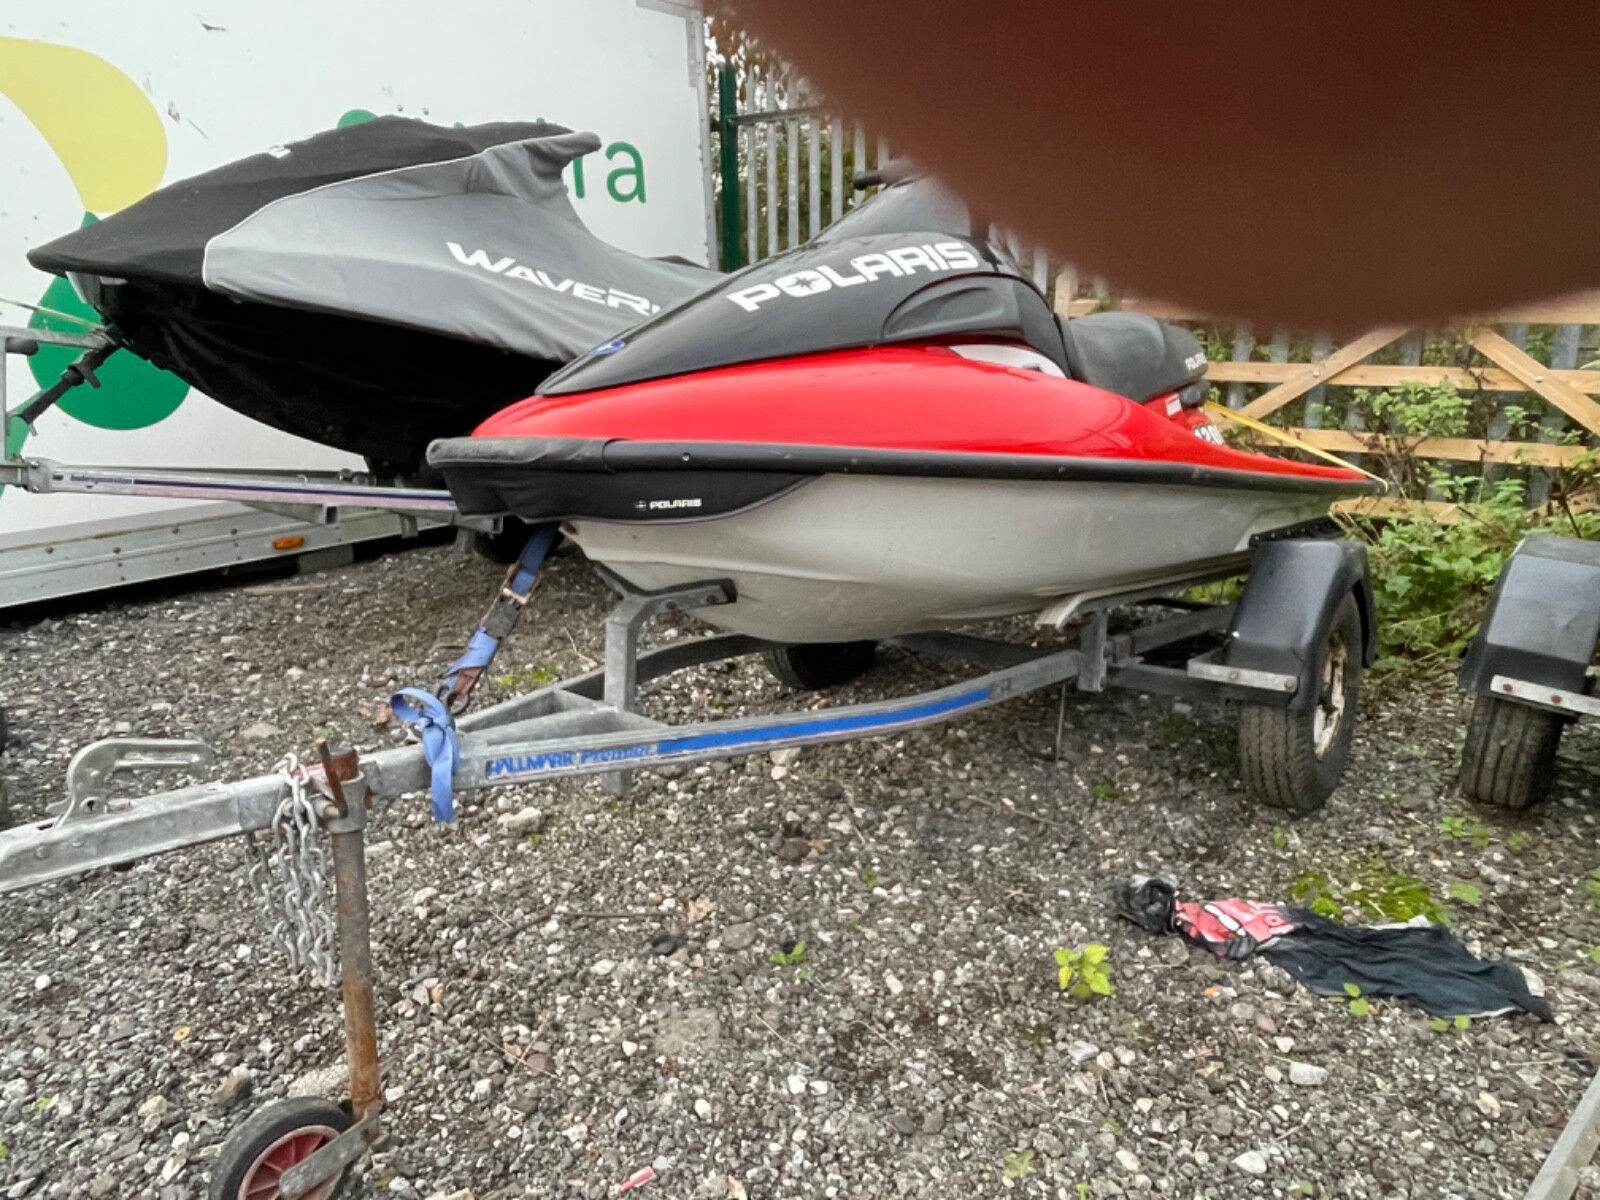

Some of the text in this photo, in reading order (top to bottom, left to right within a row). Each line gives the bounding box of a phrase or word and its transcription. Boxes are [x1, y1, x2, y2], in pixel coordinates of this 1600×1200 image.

[446, 241, 661, 317] WAVER
[726, 242, 979, 312] POLARIS
[649, 498, 702, 510] POLARIS
